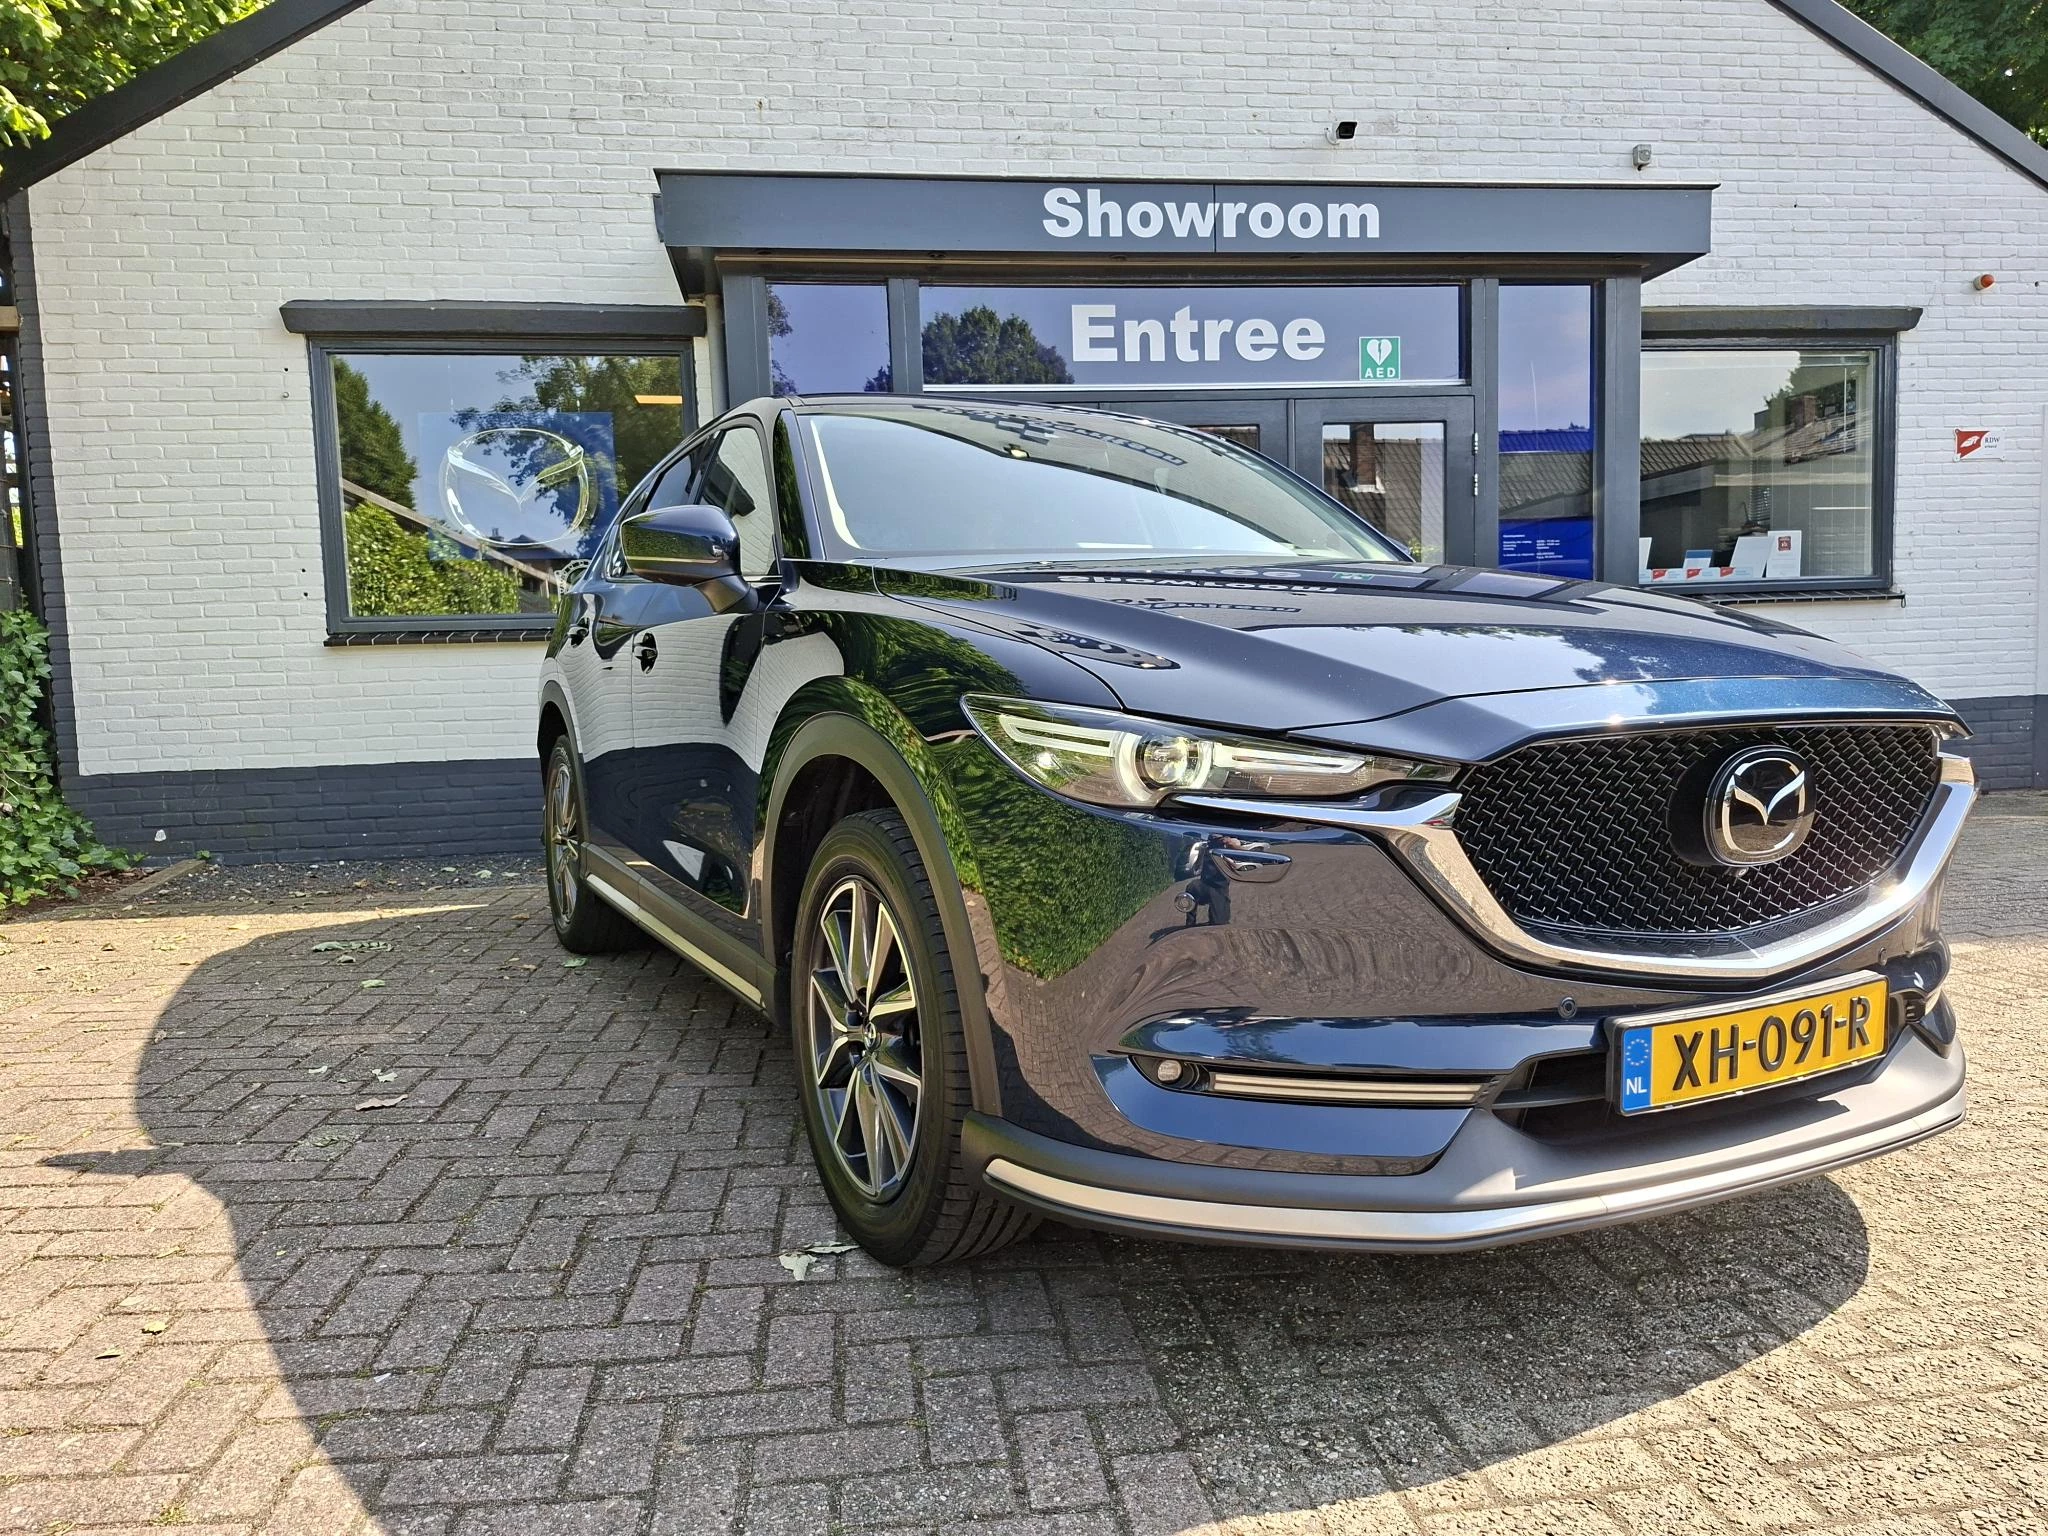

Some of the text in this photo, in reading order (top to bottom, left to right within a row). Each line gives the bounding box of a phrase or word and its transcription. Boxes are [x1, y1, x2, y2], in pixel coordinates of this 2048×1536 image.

[1042, 187, 1381, 239] Showroom
[1071, 304, 1326, 363] Entree
[1364, 367, 1396, 378] AED
[1672, 995, 1871, 1092] XH-091-R
[1626, 1076, 1648, 1096] NL
